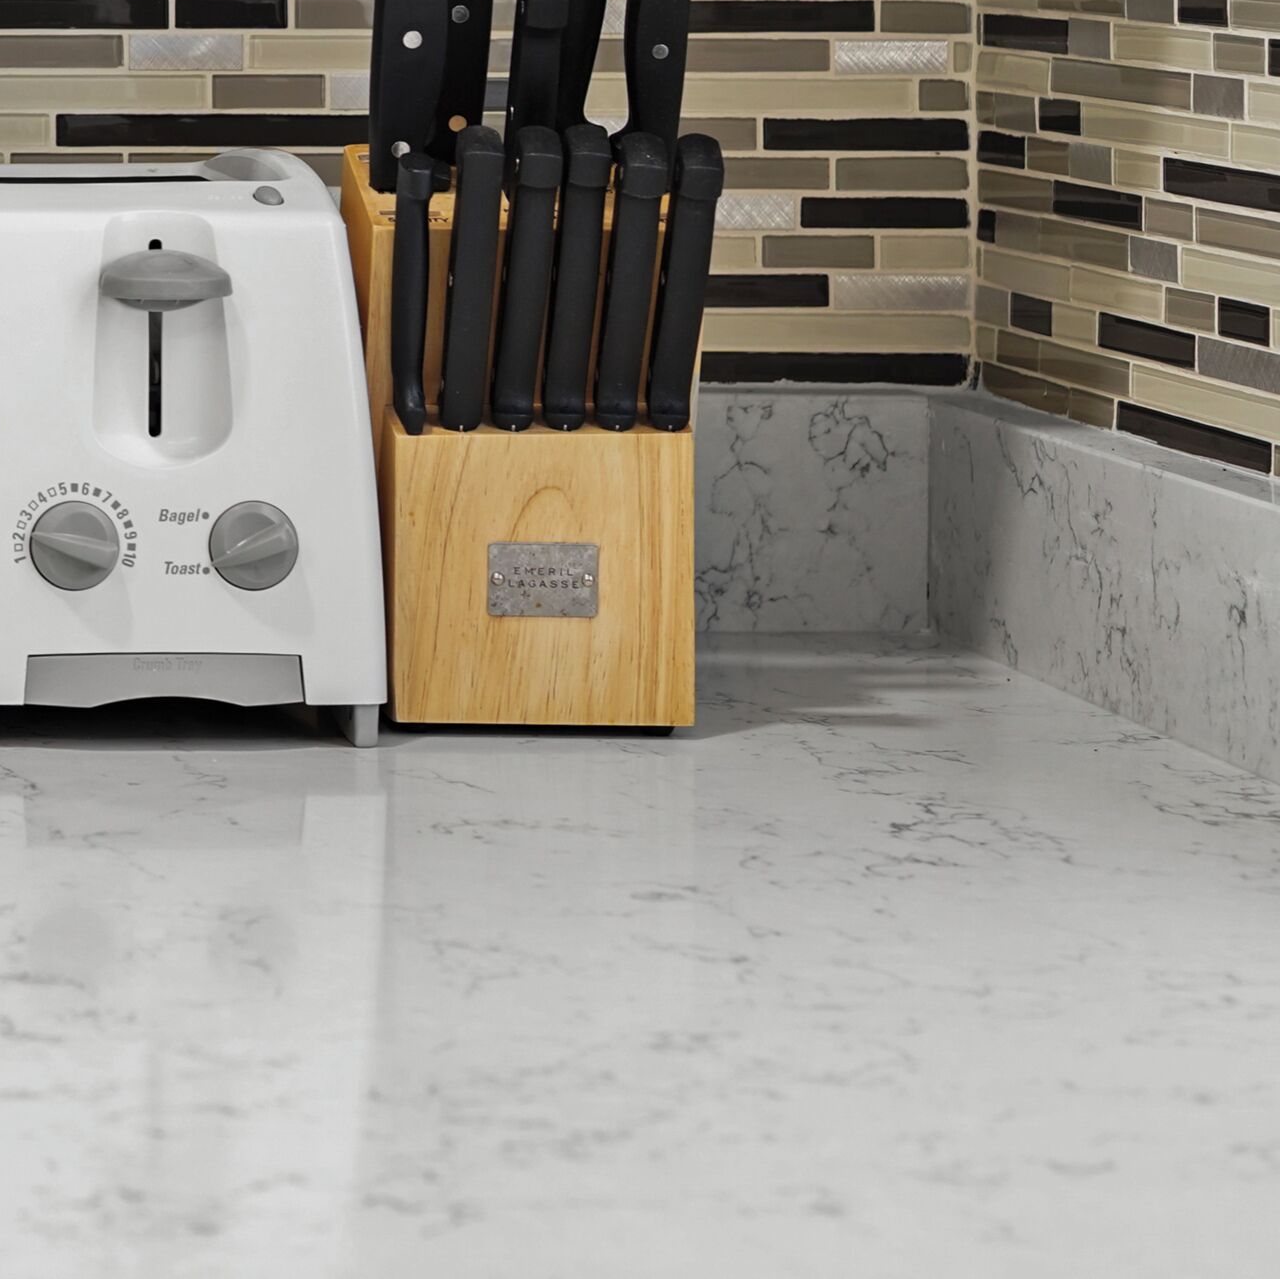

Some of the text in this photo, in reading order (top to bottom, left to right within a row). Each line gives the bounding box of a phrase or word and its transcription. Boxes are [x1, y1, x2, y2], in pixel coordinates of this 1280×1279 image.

[158, 508, 201, 526] Bagel
[12, 482, 138, 568] 1 2 3 4 5 6 7 8 9 10
[164, 561, 202, 576] Toast
[513, 566, 574, 577] EMERIL
[507, 579, 580, 589] LAGASSE
